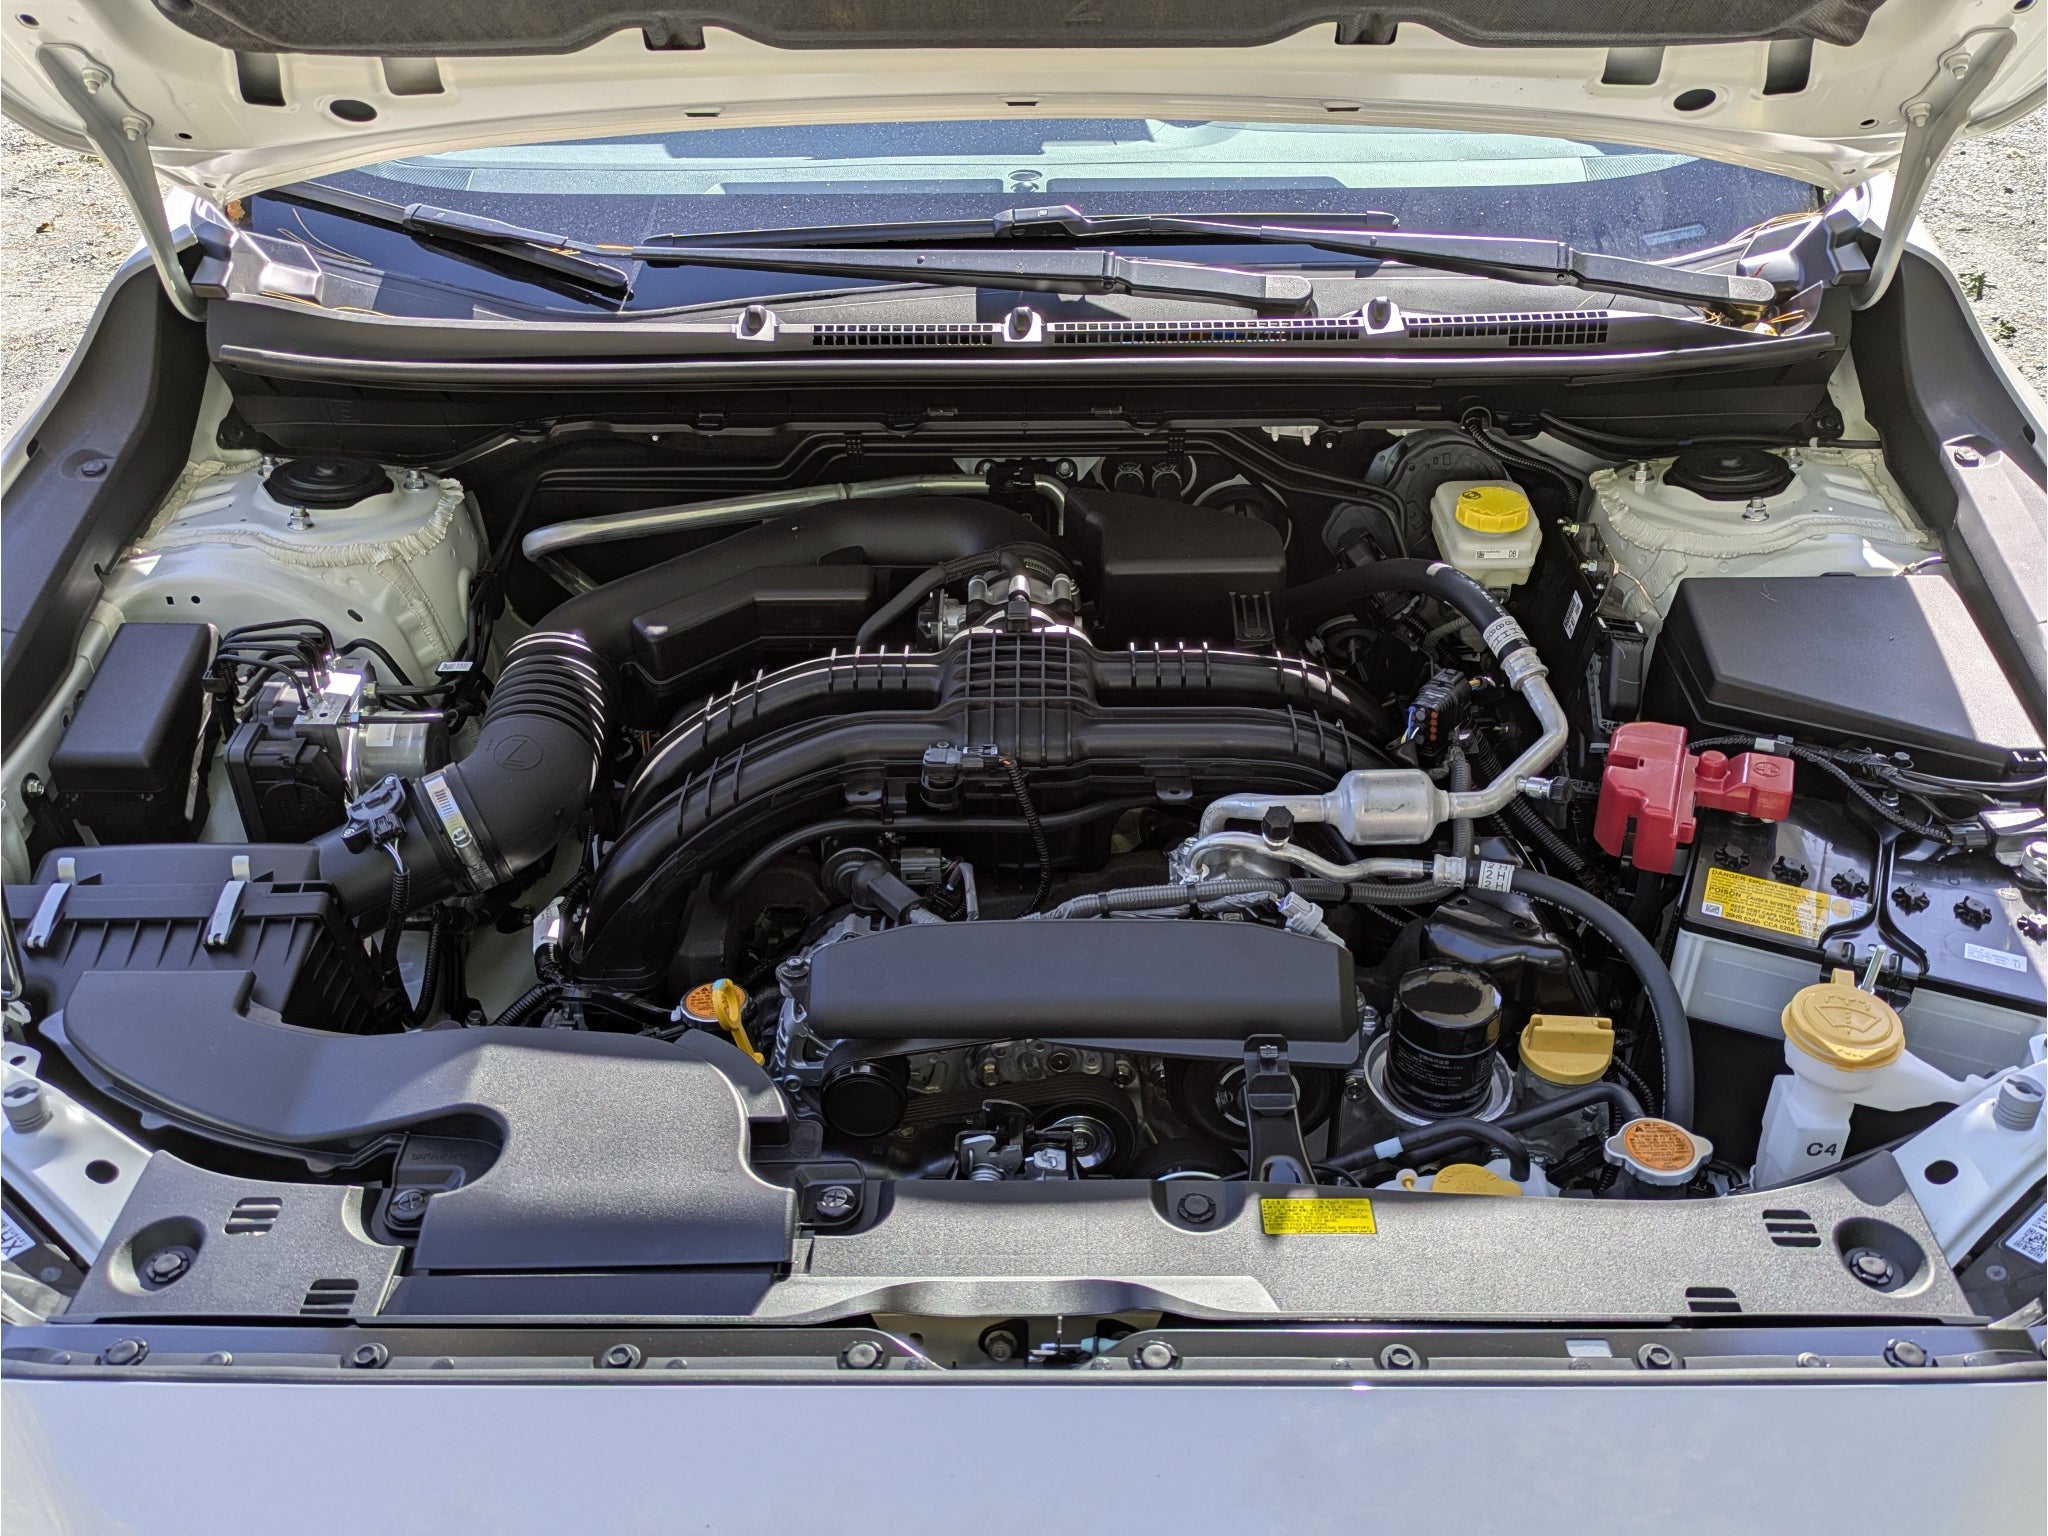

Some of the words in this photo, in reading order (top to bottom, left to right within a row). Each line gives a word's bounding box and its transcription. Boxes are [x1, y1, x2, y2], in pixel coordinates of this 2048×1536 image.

[1712, 869, 1745, 881] DANGER
[1748, 878, 1778, 889] EXPLOSIVE
[1779, 885, 1798, 894] GASES
[1708, 886, 1741, 898] POISON
[1746, 895, 1768, 904] CAUSES
[1769, 900, 1792, 909] SEVERE
[1763, 920, 1778, 930] CCA
[1806, 1142, 1838, 1157] C4
